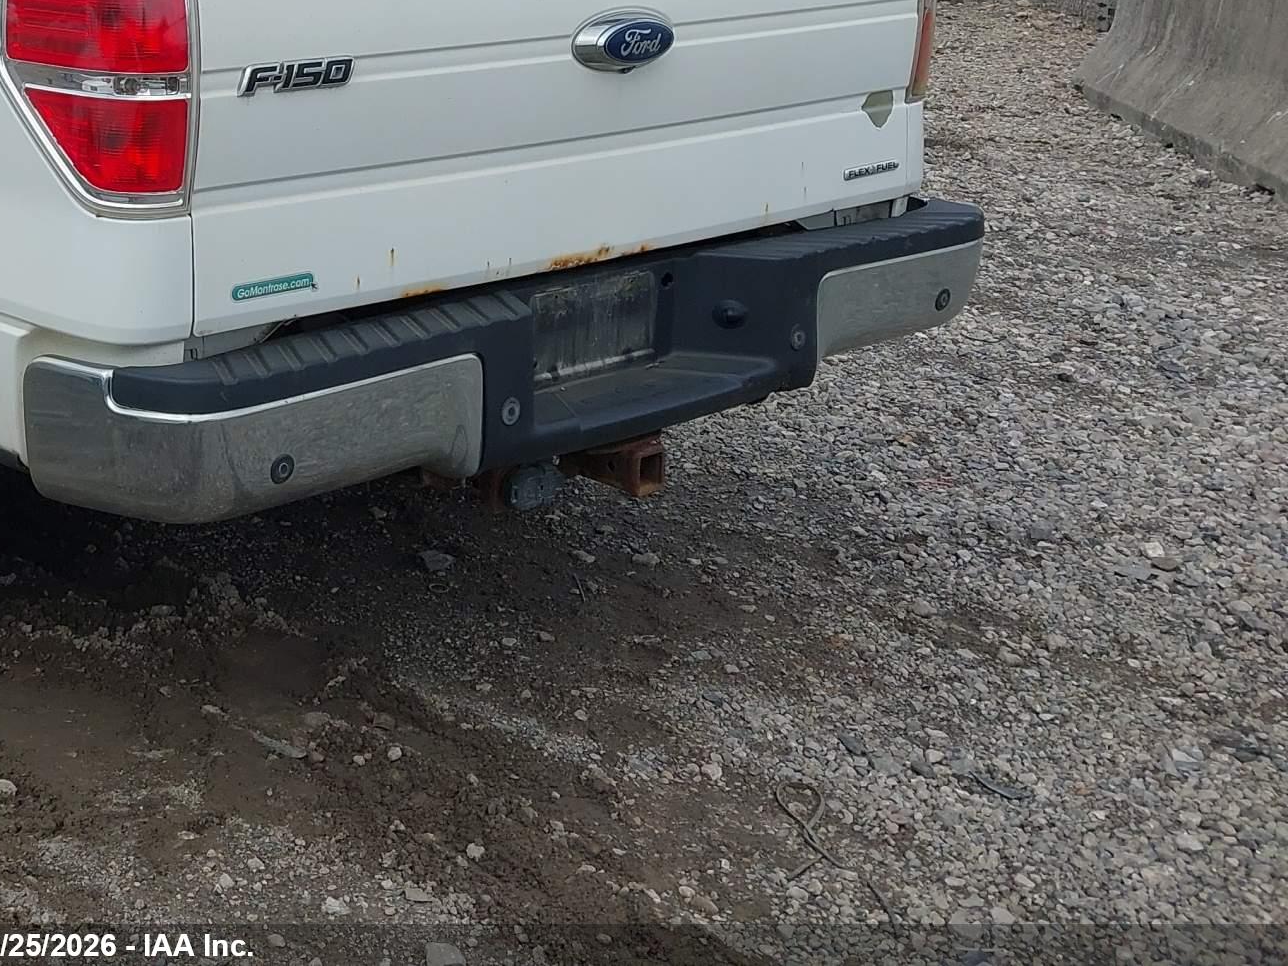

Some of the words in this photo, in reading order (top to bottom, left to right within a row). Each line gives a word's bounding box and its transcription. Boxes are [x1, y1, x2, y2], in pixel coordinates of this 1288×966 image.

[620, 28, 662, 57] Ford
[237, 55, 354, 97] F-150
[848, 166, 871, 179] FLEX
[876, 161, 899, 174] FUEL
[236, 277, 311, 299] GoMontrose.com
